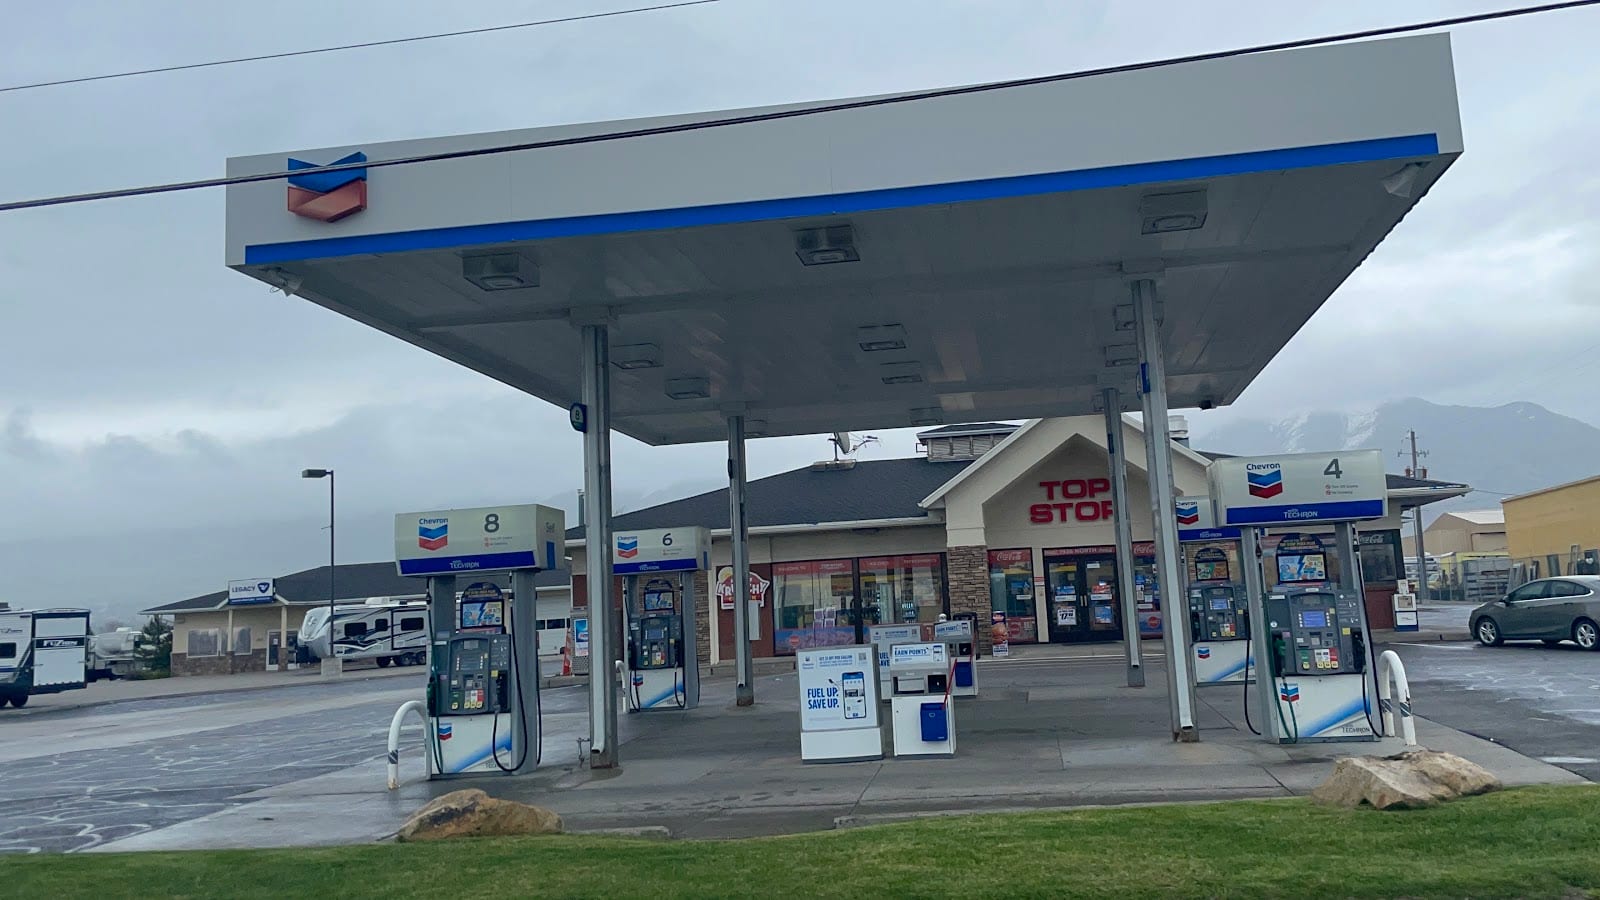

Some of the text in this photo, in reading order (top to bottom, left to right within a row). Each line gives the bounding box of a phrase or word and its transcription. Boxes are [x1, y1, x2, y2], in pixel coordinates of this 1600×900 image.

[1323, 458, 1342, 478] 4
[1040, 478, 1110, 500] TOP
[1284, 511, 1318, 519] TECHRON
[484, 513, 500, 533] 8
[662, 533, 672, 546] 6
[807, 687, 839, 698] FUEL UP.
[808, 699, 840, 709] SAVE UP.
